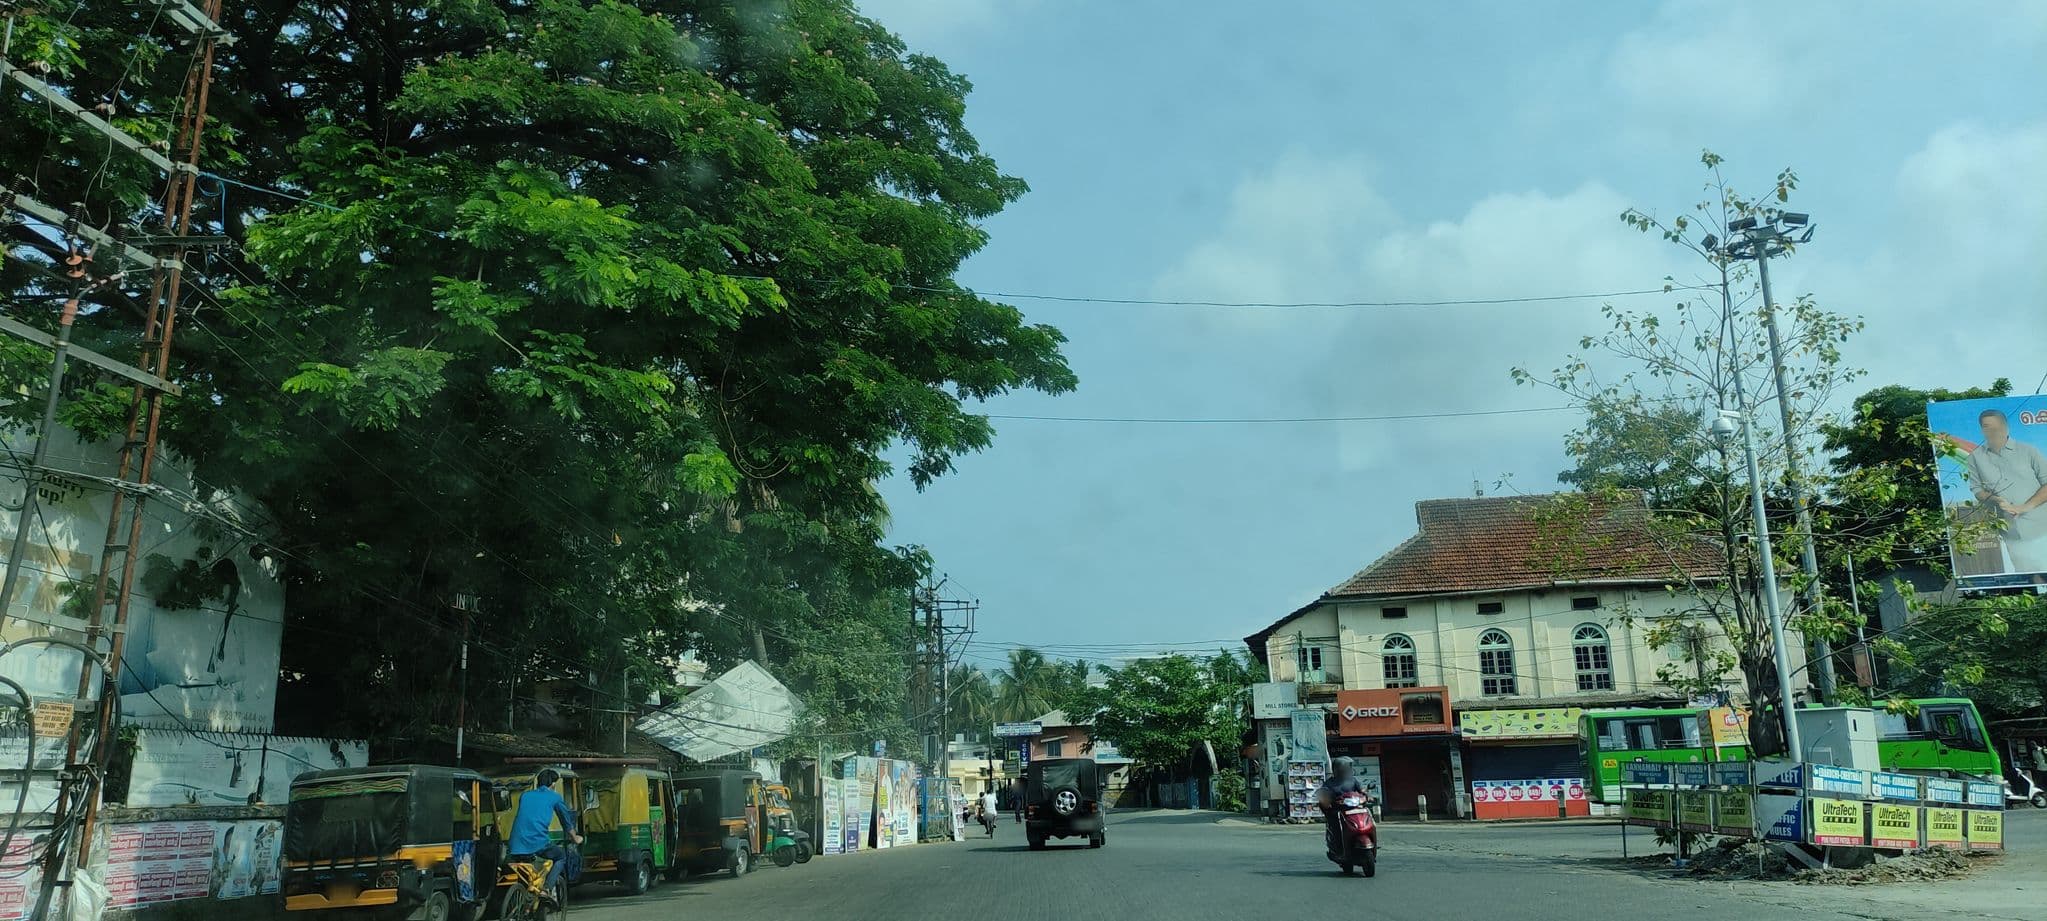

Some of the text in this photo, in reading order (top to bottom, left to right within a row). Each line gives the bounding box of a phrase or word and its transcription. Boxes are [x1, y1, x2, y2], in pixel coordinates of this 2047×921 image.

[39, 487, 66, 506] up!
[1357, 706, 1400, 718] GROZ
[1780, 769, 1799, 784] LEFT
[1823, 803, 1857, 816] UltraTech
[1879, 807, 1911, 820] UltraTech
[1933, 811, 1958, 822] UltraTech
[1974, 813, 1998, 825] UltraTech
